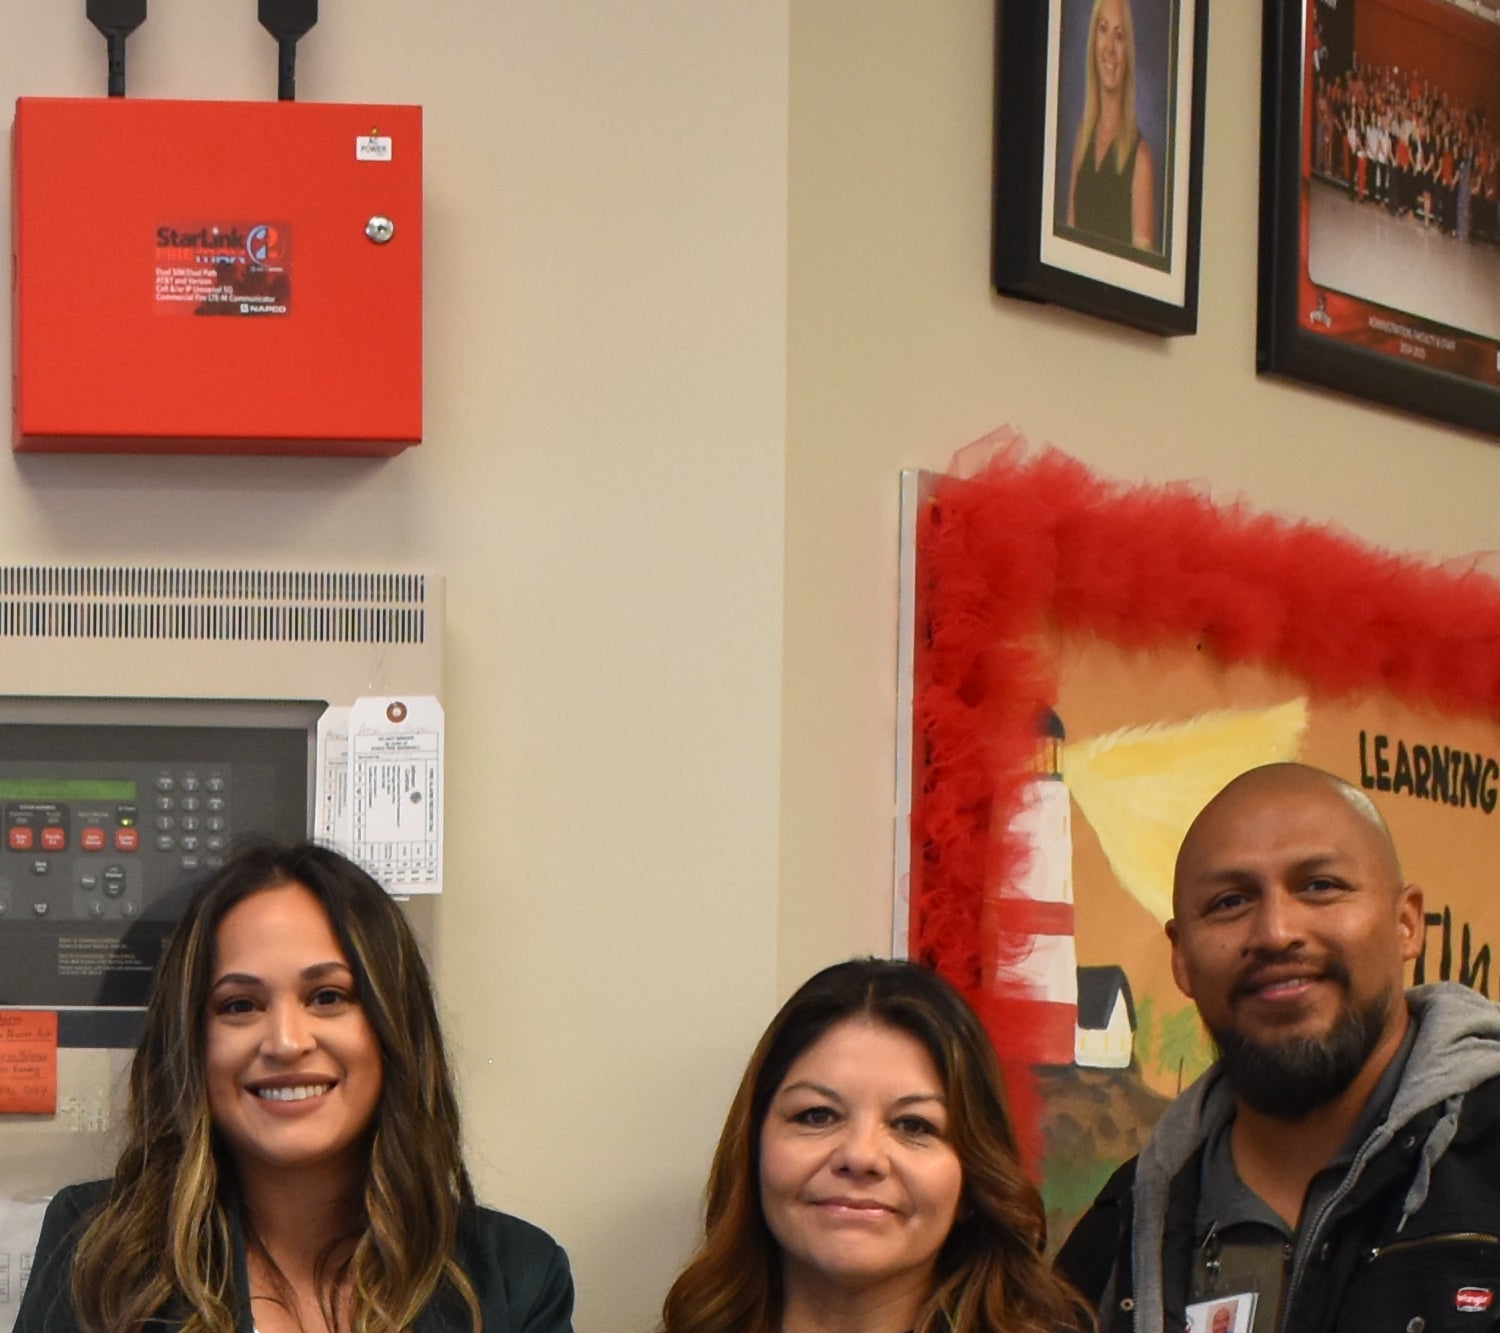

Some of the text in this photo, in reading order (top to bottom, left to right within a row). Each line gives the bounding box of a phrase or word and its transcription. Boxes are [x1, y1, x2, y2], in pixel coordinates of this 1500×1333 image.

[157, 227, 243, 248] StarLink
[250, 305, 286, 313] NAPCO
[1359, 730, 1500, 814] LEARNING
